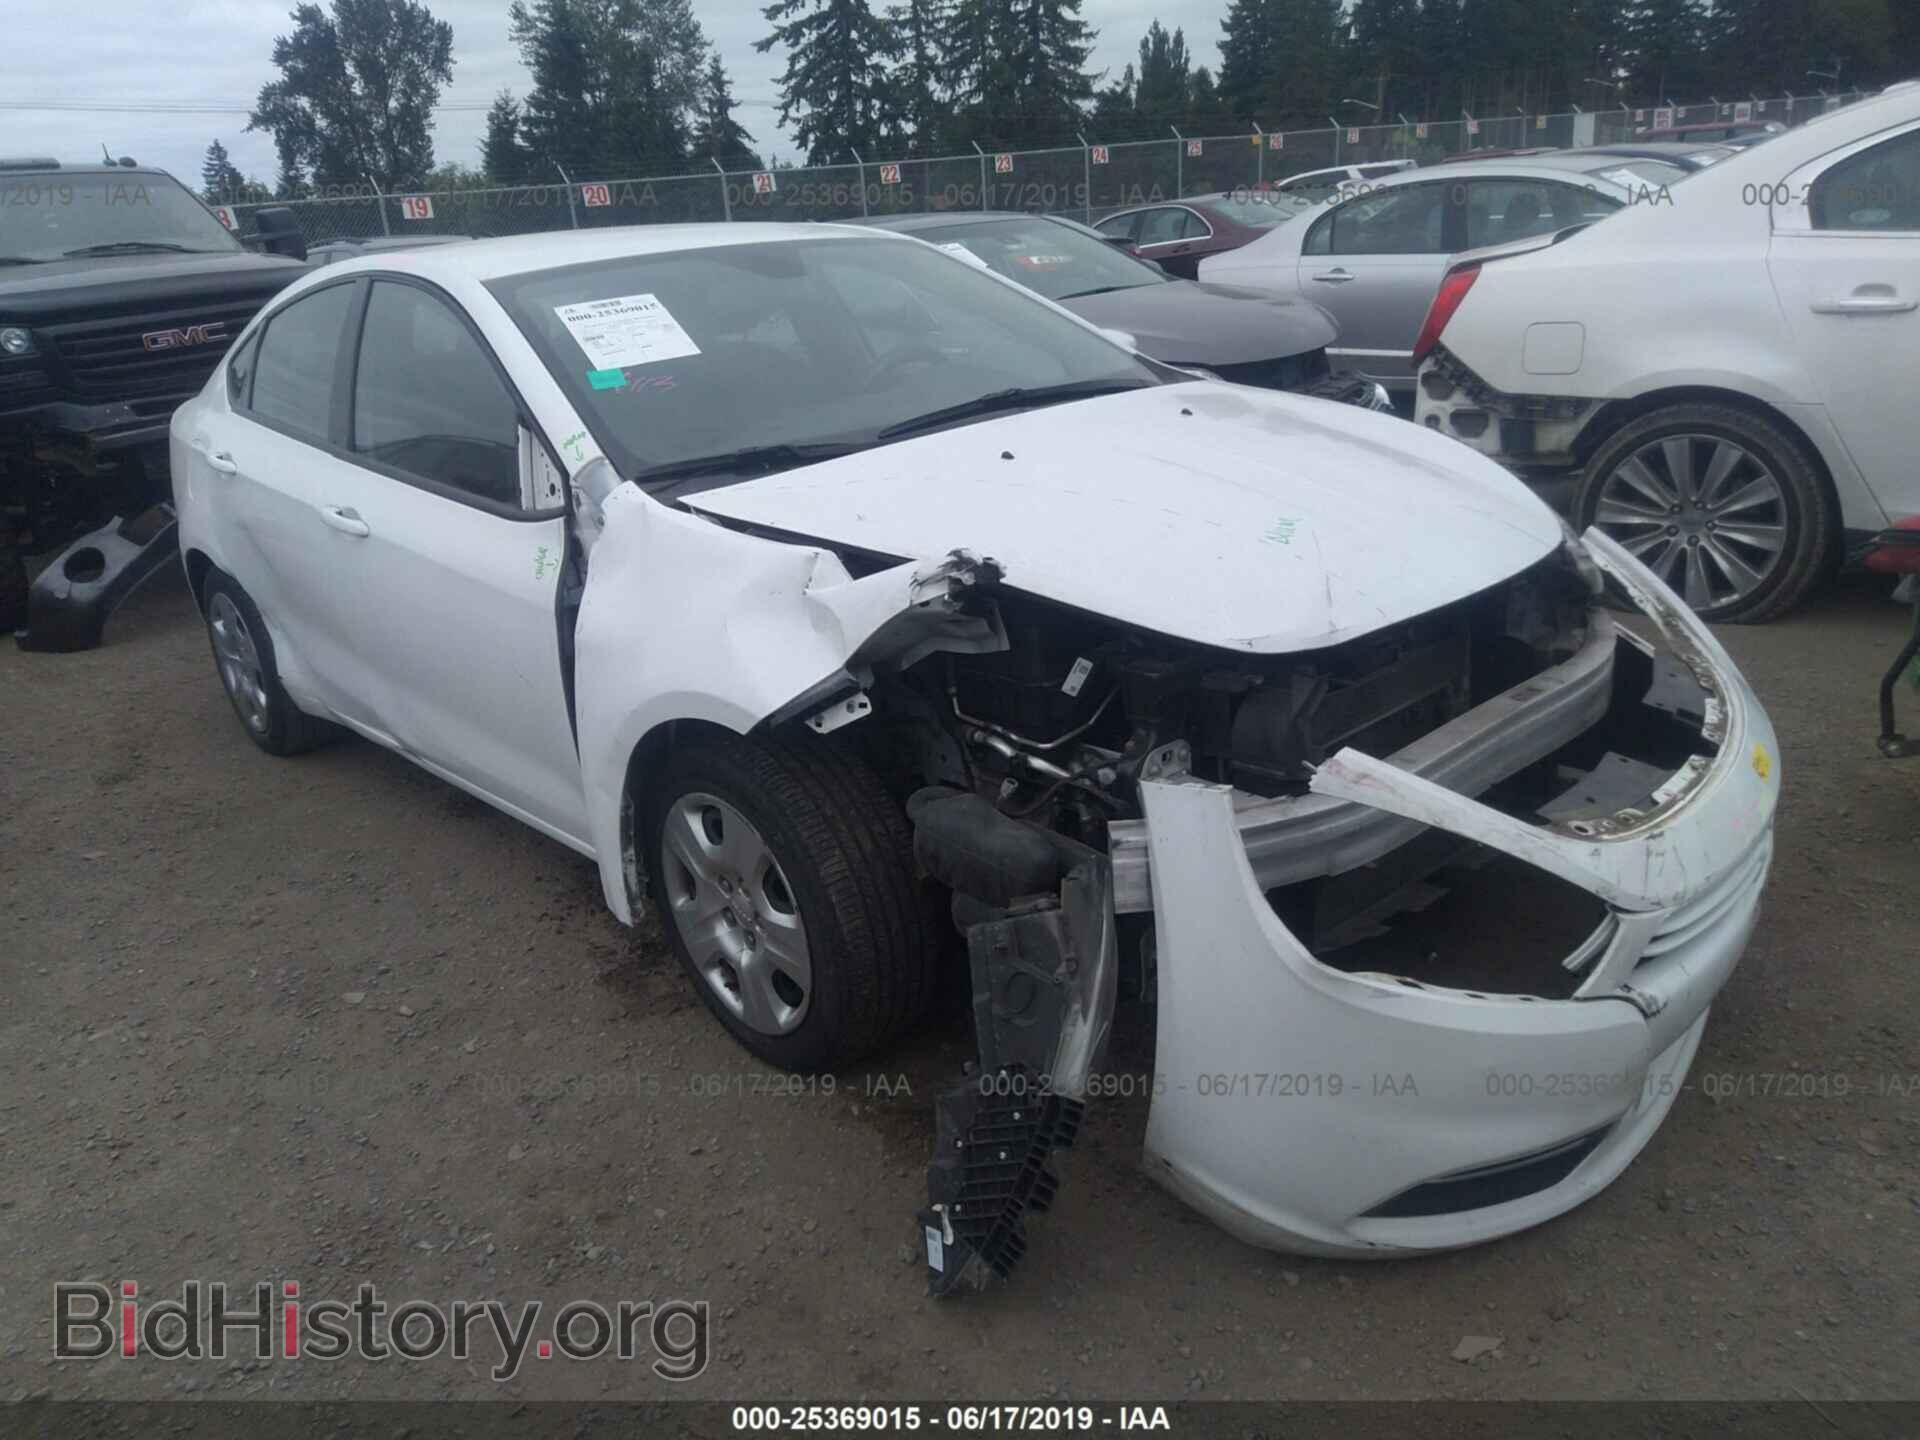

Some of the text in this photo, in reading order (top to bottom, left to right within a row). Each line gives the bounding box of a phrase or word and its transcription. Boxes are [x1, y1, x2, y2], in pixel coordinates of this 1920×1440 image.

[757, 175, 772, 192] 21
[881, 166, 898, 182] 22
[585, 186, 608, 205] 20
[406, 199, 429, 218] 19
[142, 322, 226, 352] GMC
